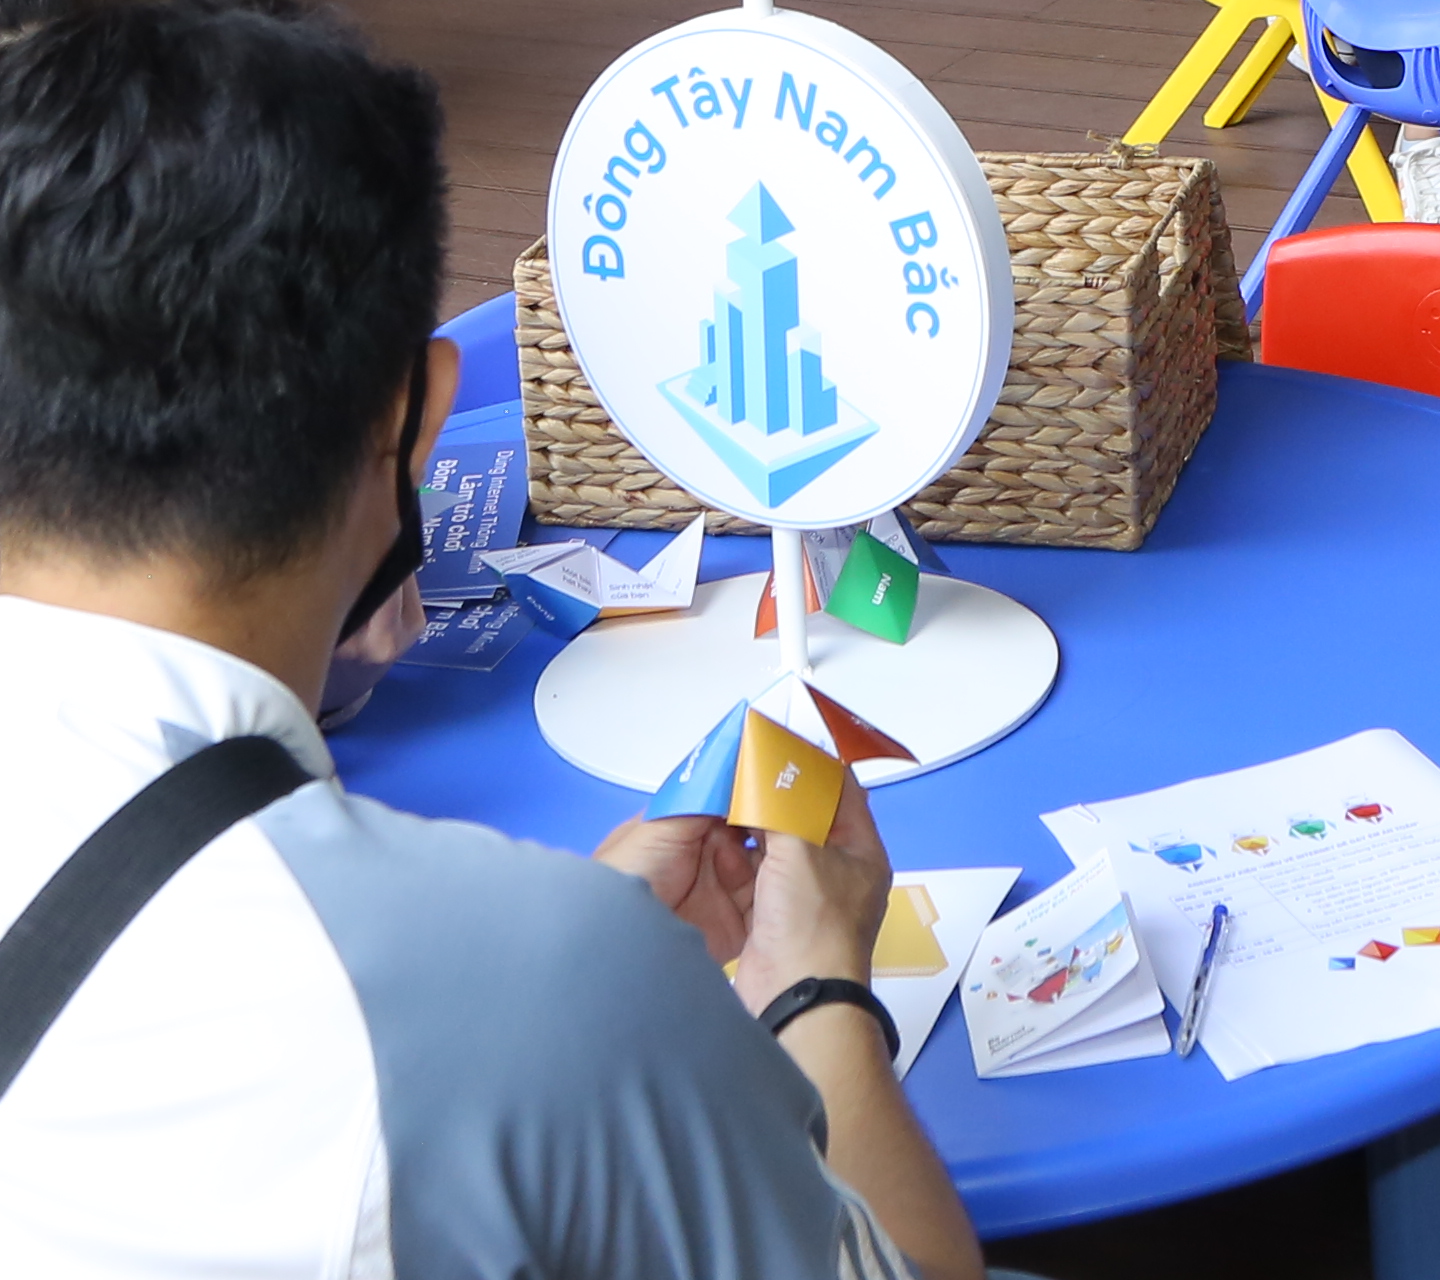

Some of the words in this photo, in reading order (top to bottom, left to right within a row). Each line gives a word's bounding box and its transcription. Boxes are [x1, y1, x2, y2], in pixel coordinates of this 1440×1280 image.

[582, 119, 667, 282] Đông
[650, 66, 753, 130] Tây
[774, 71, 897, 202] Nam
[889, 210, 960, 339] Bắc
[458, 474, 483, 501] Làm
[481, 476, 507, 516] Internet
[443, 523, 471, 553] chơi
[871, 573, 892, 606] Nam
